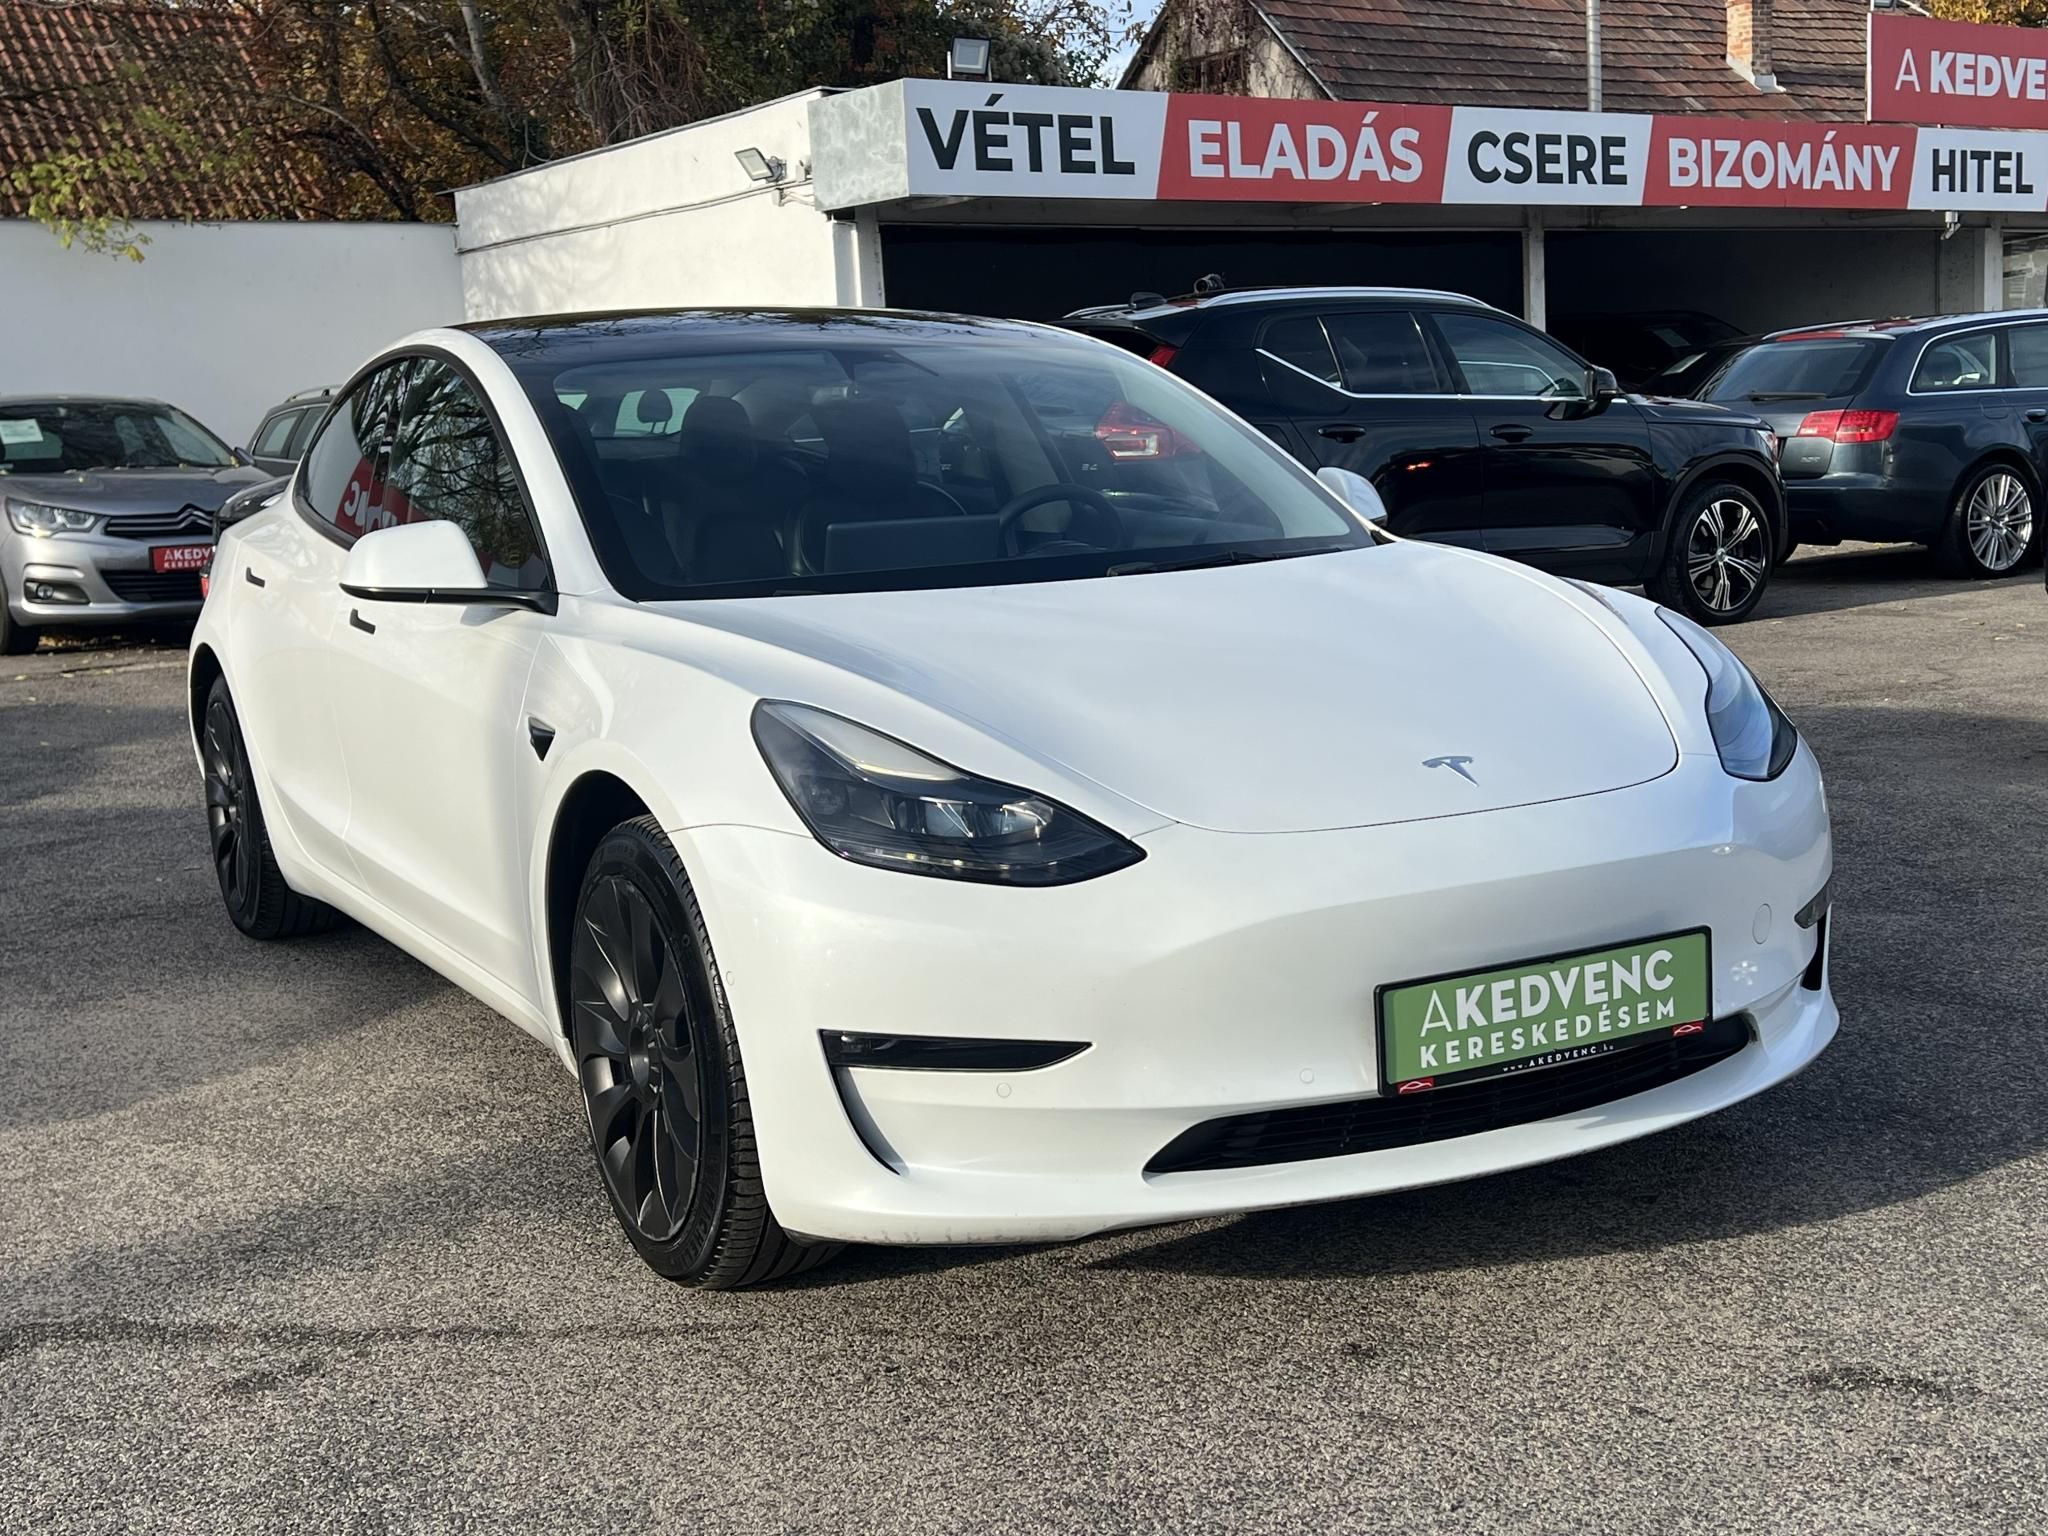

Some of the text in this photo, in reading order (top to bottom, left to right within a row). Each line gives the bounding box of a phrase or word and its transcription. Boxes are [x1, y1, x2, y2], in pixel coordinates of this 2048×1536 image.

[1895, 48, 1921, 92] A
[916, 93, 2034, 194] VÉTEL ELADÁS CSERE BIZOMÁNY HITEL
[1420, 997, 1676, 1069] KERESKEDÉSEM
